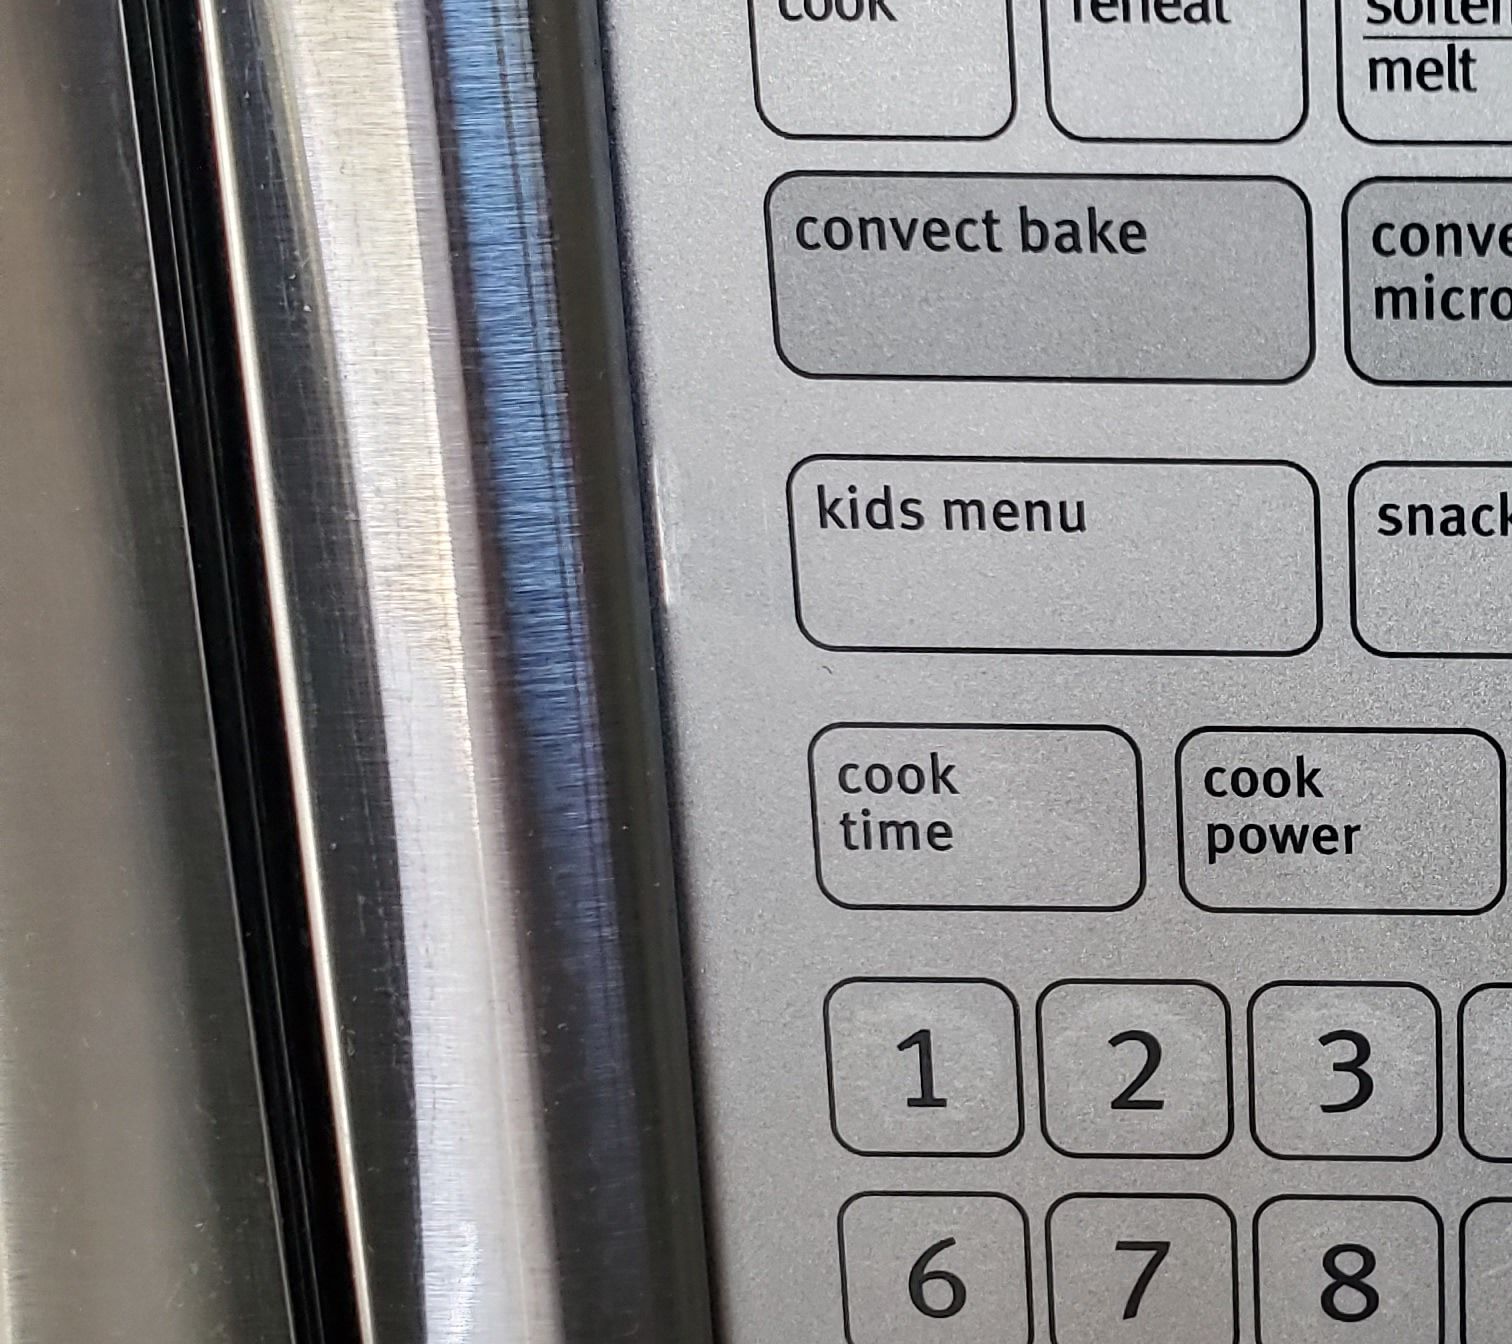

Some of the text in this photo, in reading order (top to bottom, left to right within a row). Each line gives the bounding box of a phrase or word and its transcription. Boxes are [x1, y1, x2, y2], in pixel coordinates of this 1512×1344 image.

[1369, 43, 1476, 92] melt
[796, 206, 1146, 254] convect bake
[817, 484, 1086, 532] kids menu
[838, 752, 959, 794] cook
[1204, 755, 1323, 798] cook
[839, 808, 952, 851] time
[1208, 824, 1361, 864] power
[897, 1029, 947, 1108] 1
[1108, 1030, 1164, 1110] 2
[1318, 1030, 1373, 1113] 3
[908, 1237, 966, 1318] 6
[1115, 1241, 1170, 1320] 7
[1321, 1244, 1379, 1323] 8
